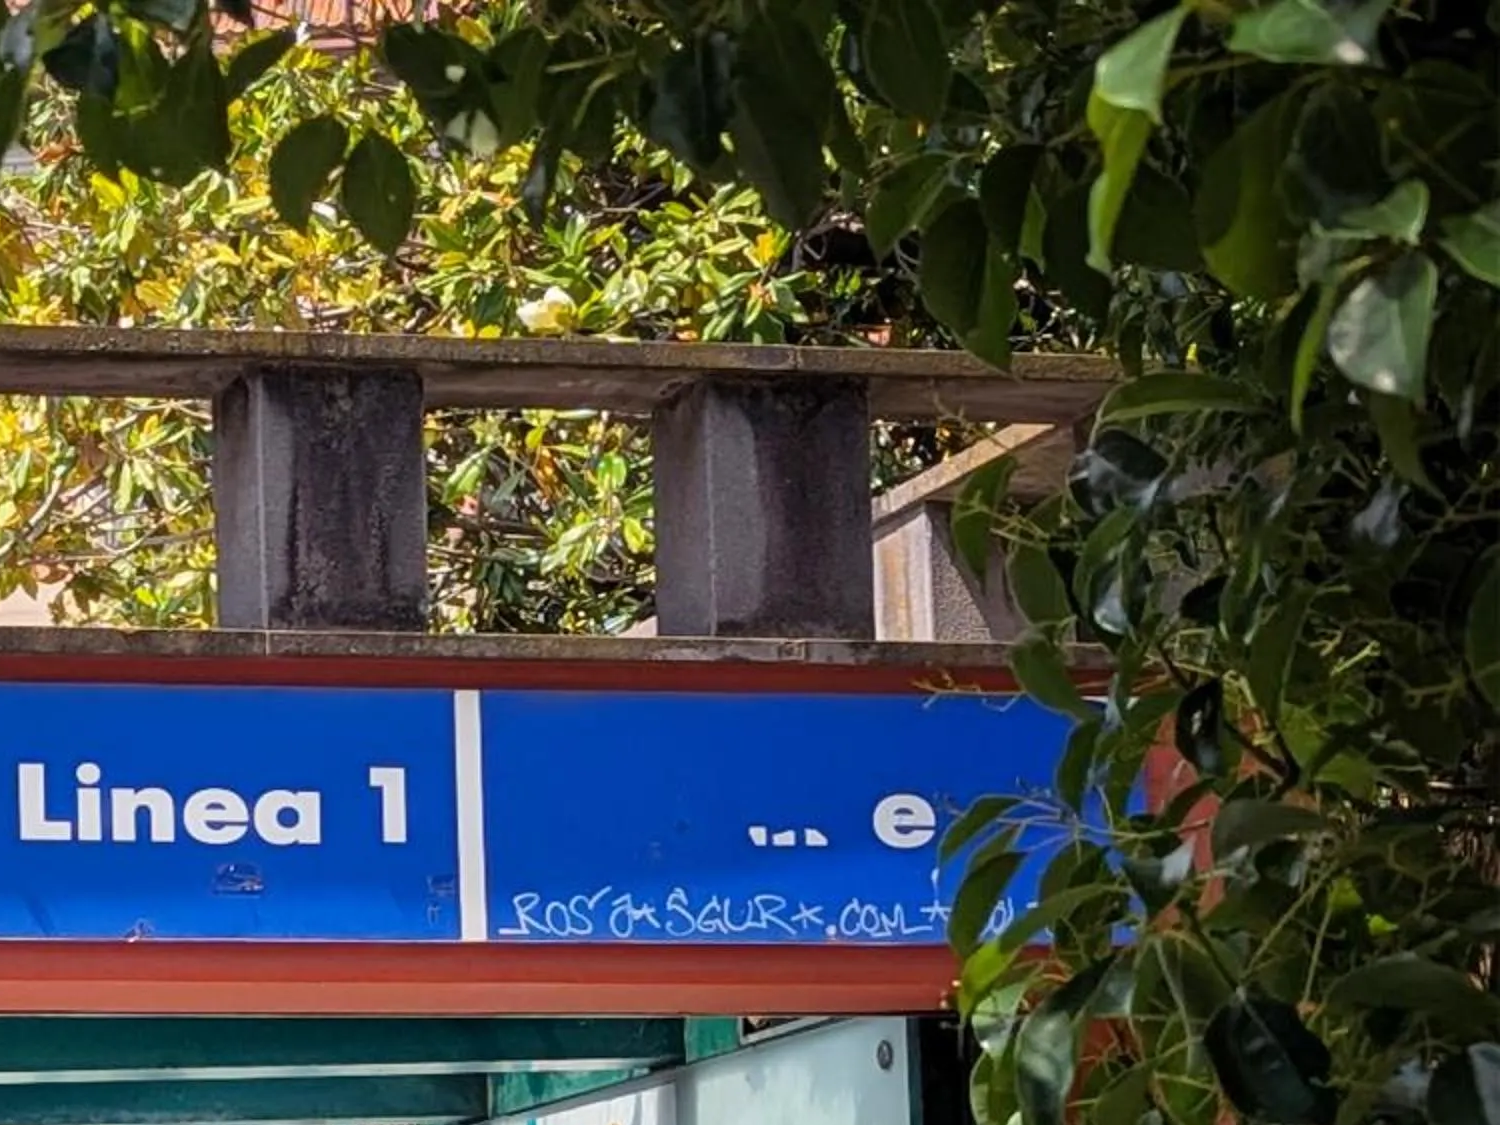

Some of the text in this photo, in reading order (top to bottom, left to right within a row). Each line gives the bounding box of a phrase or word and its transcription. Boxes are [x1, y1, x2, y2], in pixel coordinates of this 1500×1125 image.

[18, 762, 322, 845] Linea
[370, 766, 408, 843] 1
[873, 793, 937, 849] e
